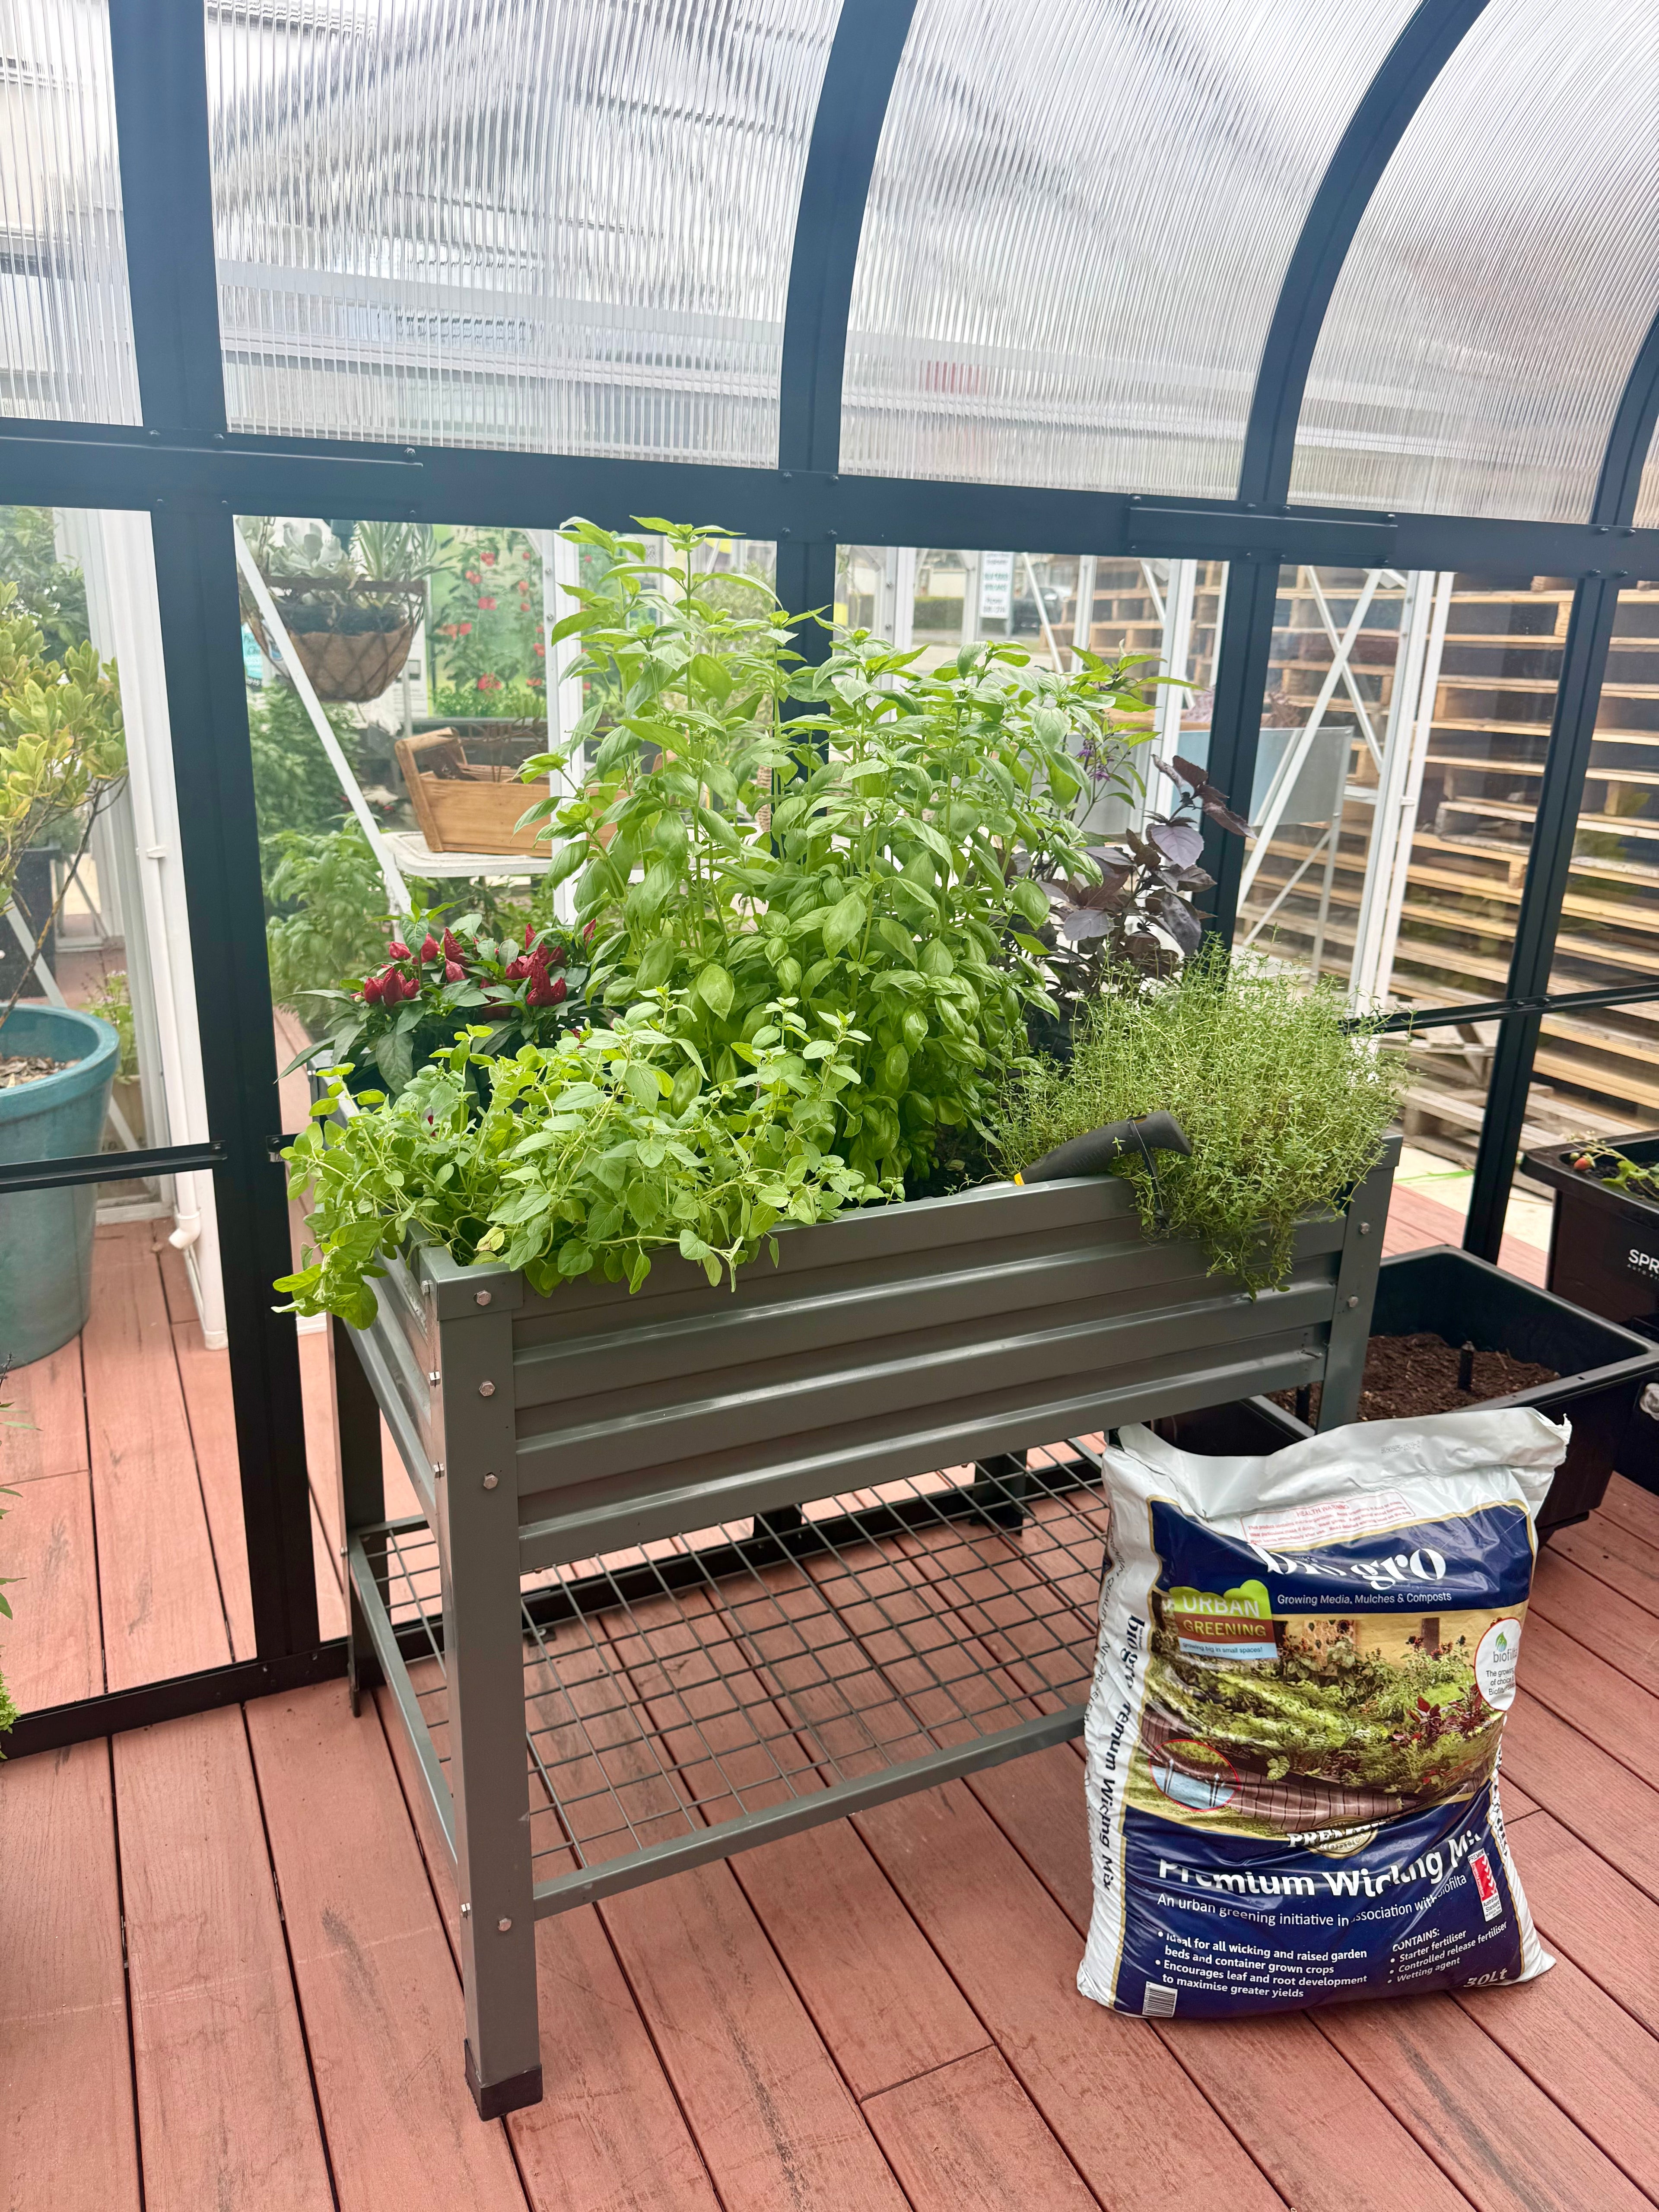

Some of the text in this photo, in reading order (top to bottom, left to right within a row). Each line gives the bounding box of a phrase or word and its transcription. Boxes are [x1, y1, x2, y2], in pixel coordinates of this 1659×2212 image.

[1297, 1507, 1321, 1517] HEALTH
[1351, 1548, 1446, 1590] gro
[1182, 1595, 1260, 1618] URBAN
[1278, 1594, 1318, 1606] Growing
[1355, 1594, 1395, 1604] Mulches
[1397, 1593, 1404, 1602] &
[1406, 1592, 1452, 1603] Composts
[1127, 1615, 1145, 1649] bio
[1183, 1620, 1267, 1637] GREENING
[1182, 1643, 1204, 1651] growing
[1120, 1648, 1138, 1689] gro
[1287, 1821, 1386, 1848] PREM
[1102, 1854, 1114, 1891] Mix
[1157, 1893, 1175, 1907] An
[1179, 1899, 1215, 1913] urban
[1219, 1907, 1276, 1926] greening
[1280, 1913, 1334, 1926] initiative
[1338, 1914, 1349, 1927] in
[1351, 1903, 1412, 1923] ssociation
[1414, 1894, 1437, 1911] with
[1194, 1938, 1210, 1950] for
[1212, 1941, 1227, 1951] all
[1229, 1943, 1271, 1958] wicking
[1274, 1950, 1294, 1959] and
[1297, 1951, 1328, 1961] raised
[1331, 1949, 1367, 1963] garden
[1392, 1928, 1440, 1952] CONTAINS:
[1398, 1921, 1507, 1973] Controlled release fertiliser
[1399, 1930, 1467, 1962] Starter fertiliser
[1163, 1960, 1367, 1987] Encourages leaf and root development
[1165, 1945, 1334, 1976] beds and container grown crops
[1397, 1957, 1461, 1983] Wetting agent
[1162, 1974, 1304, 1998] to maximise greater yields
